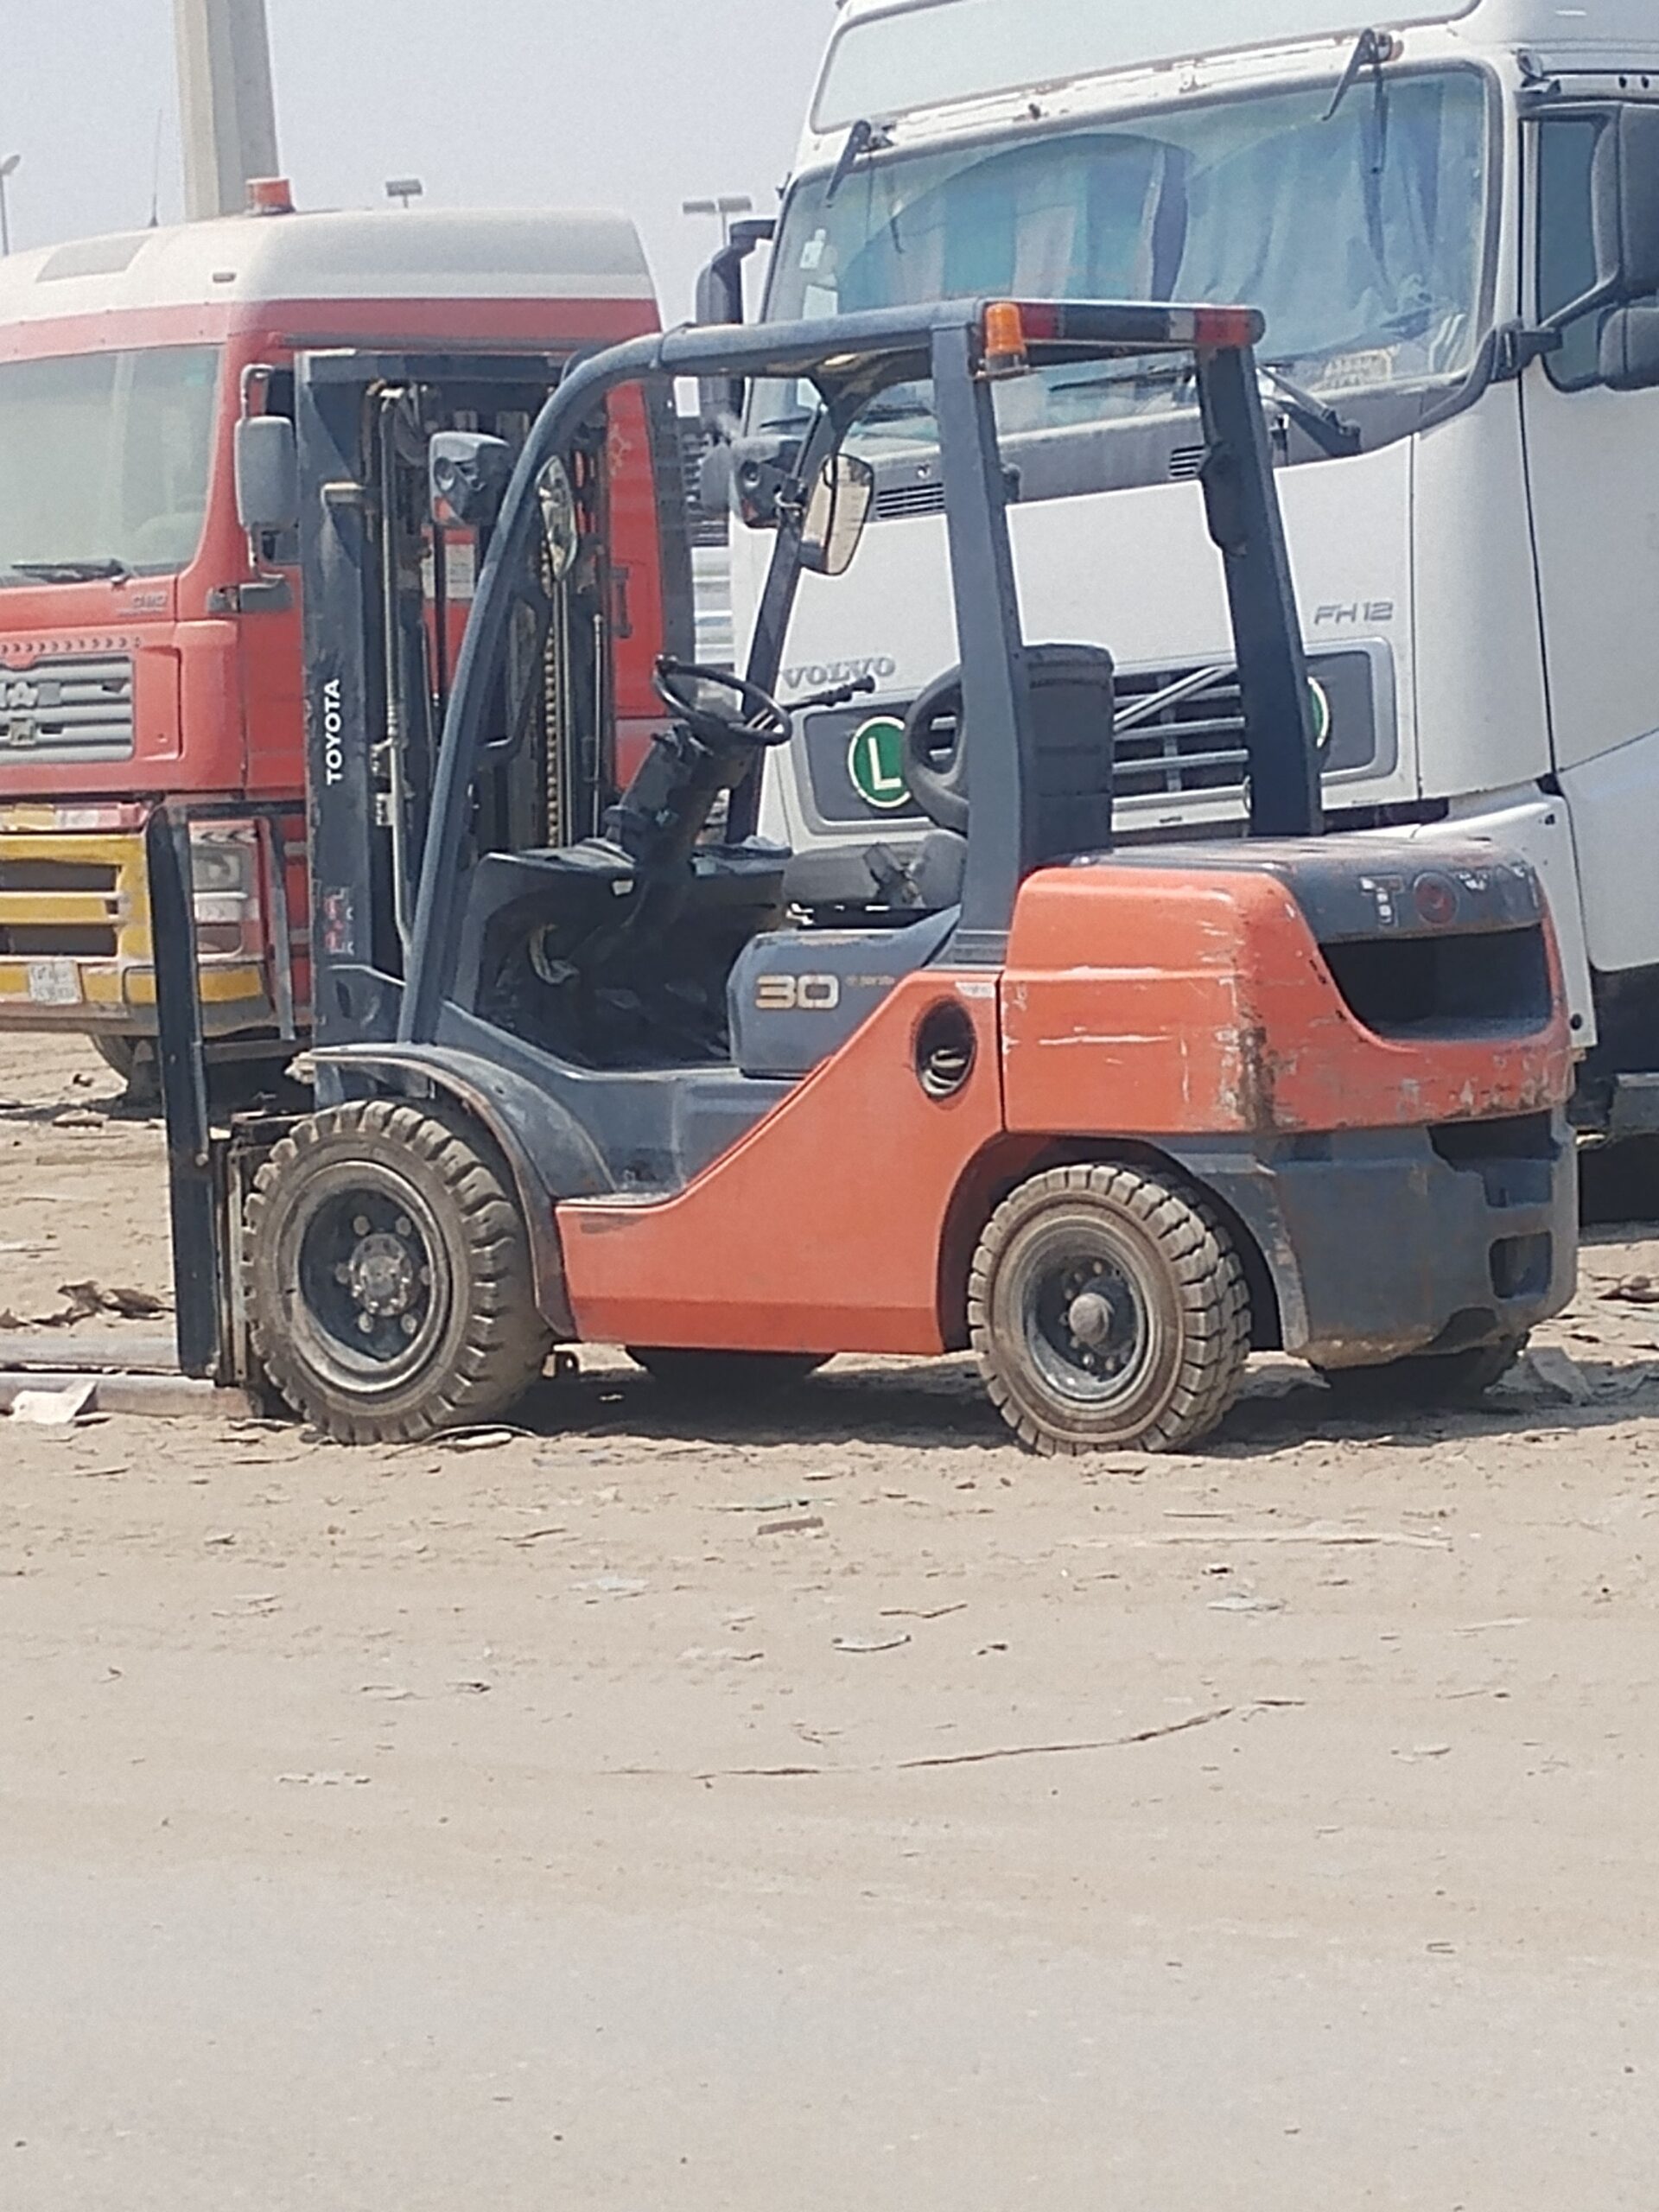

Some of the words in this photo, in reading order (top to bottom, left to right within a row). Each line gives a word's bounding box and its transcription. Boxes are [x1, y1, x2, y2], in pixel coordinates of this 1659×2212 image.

[782, 657, 896, 689] VOLVO
[324, 678, 343, 785] TOYOTA
[868, 737, 902, 790] L
[755, 975, 839, 1008] 30
